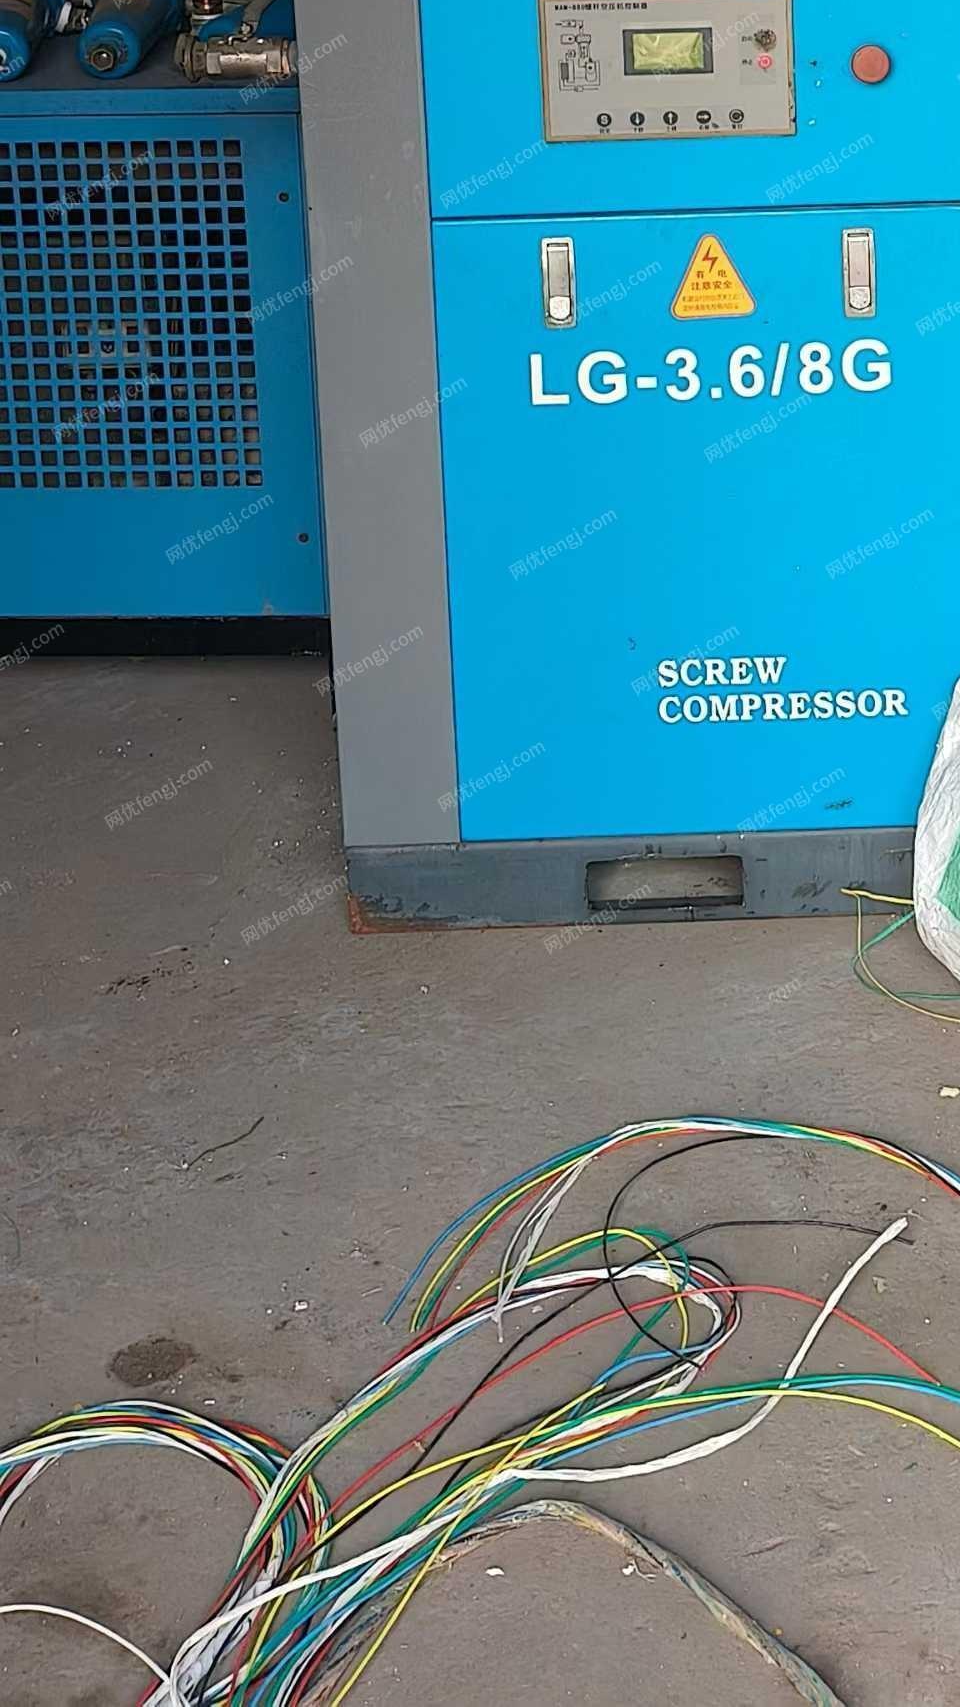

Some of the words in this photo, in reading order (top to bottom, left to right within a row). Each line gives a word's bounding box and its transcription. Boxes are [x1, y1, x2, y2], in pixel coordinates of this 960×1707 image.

[529, 338, 893, 406] LG-3.6/8G
[657, 656, 787, 688] SCREW
[657, 689, 909, 724] COMPRESSOR
